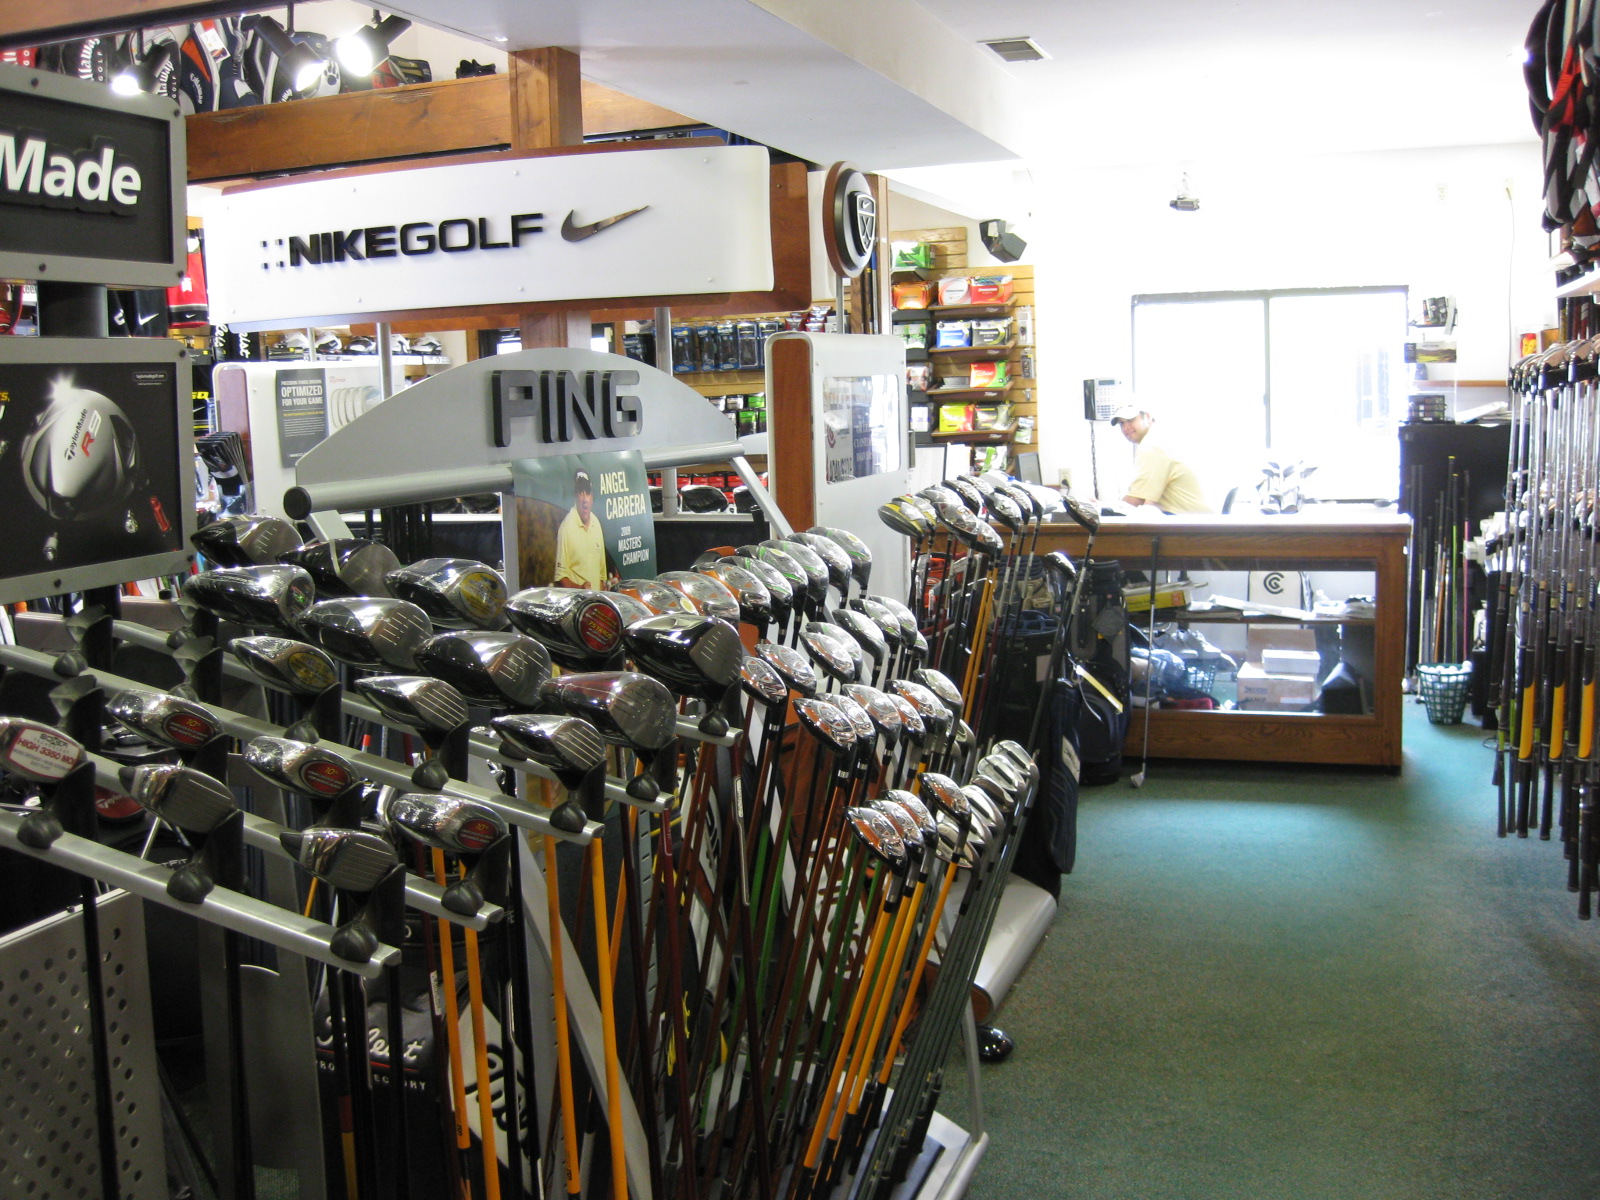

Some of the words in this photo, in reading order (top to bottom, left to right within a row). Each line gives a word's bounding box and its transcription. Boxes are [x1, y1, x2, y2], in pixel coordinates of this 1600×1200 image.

[0, 134, 142, 205] Made
[281, 385, 323, 397] OPTIMIZED
[282, 398, 292, 406] FOR
[293, 397, 308, 406] YOUR
[308, 396, 323, 405] GAME
[492, 369, 643, 448] PING
[64, 408, 88, 461] TaylorMade
[600, 471, 629, 495] ANGEL
[606, 493, 646, 520] CABRERA
[621, 525, 631, 536] 2009
[618, 536, 642, 552] MASTERS
[622, 548, 650, 566] CHAMPION
[17, 738, 39, 752] HIGH
